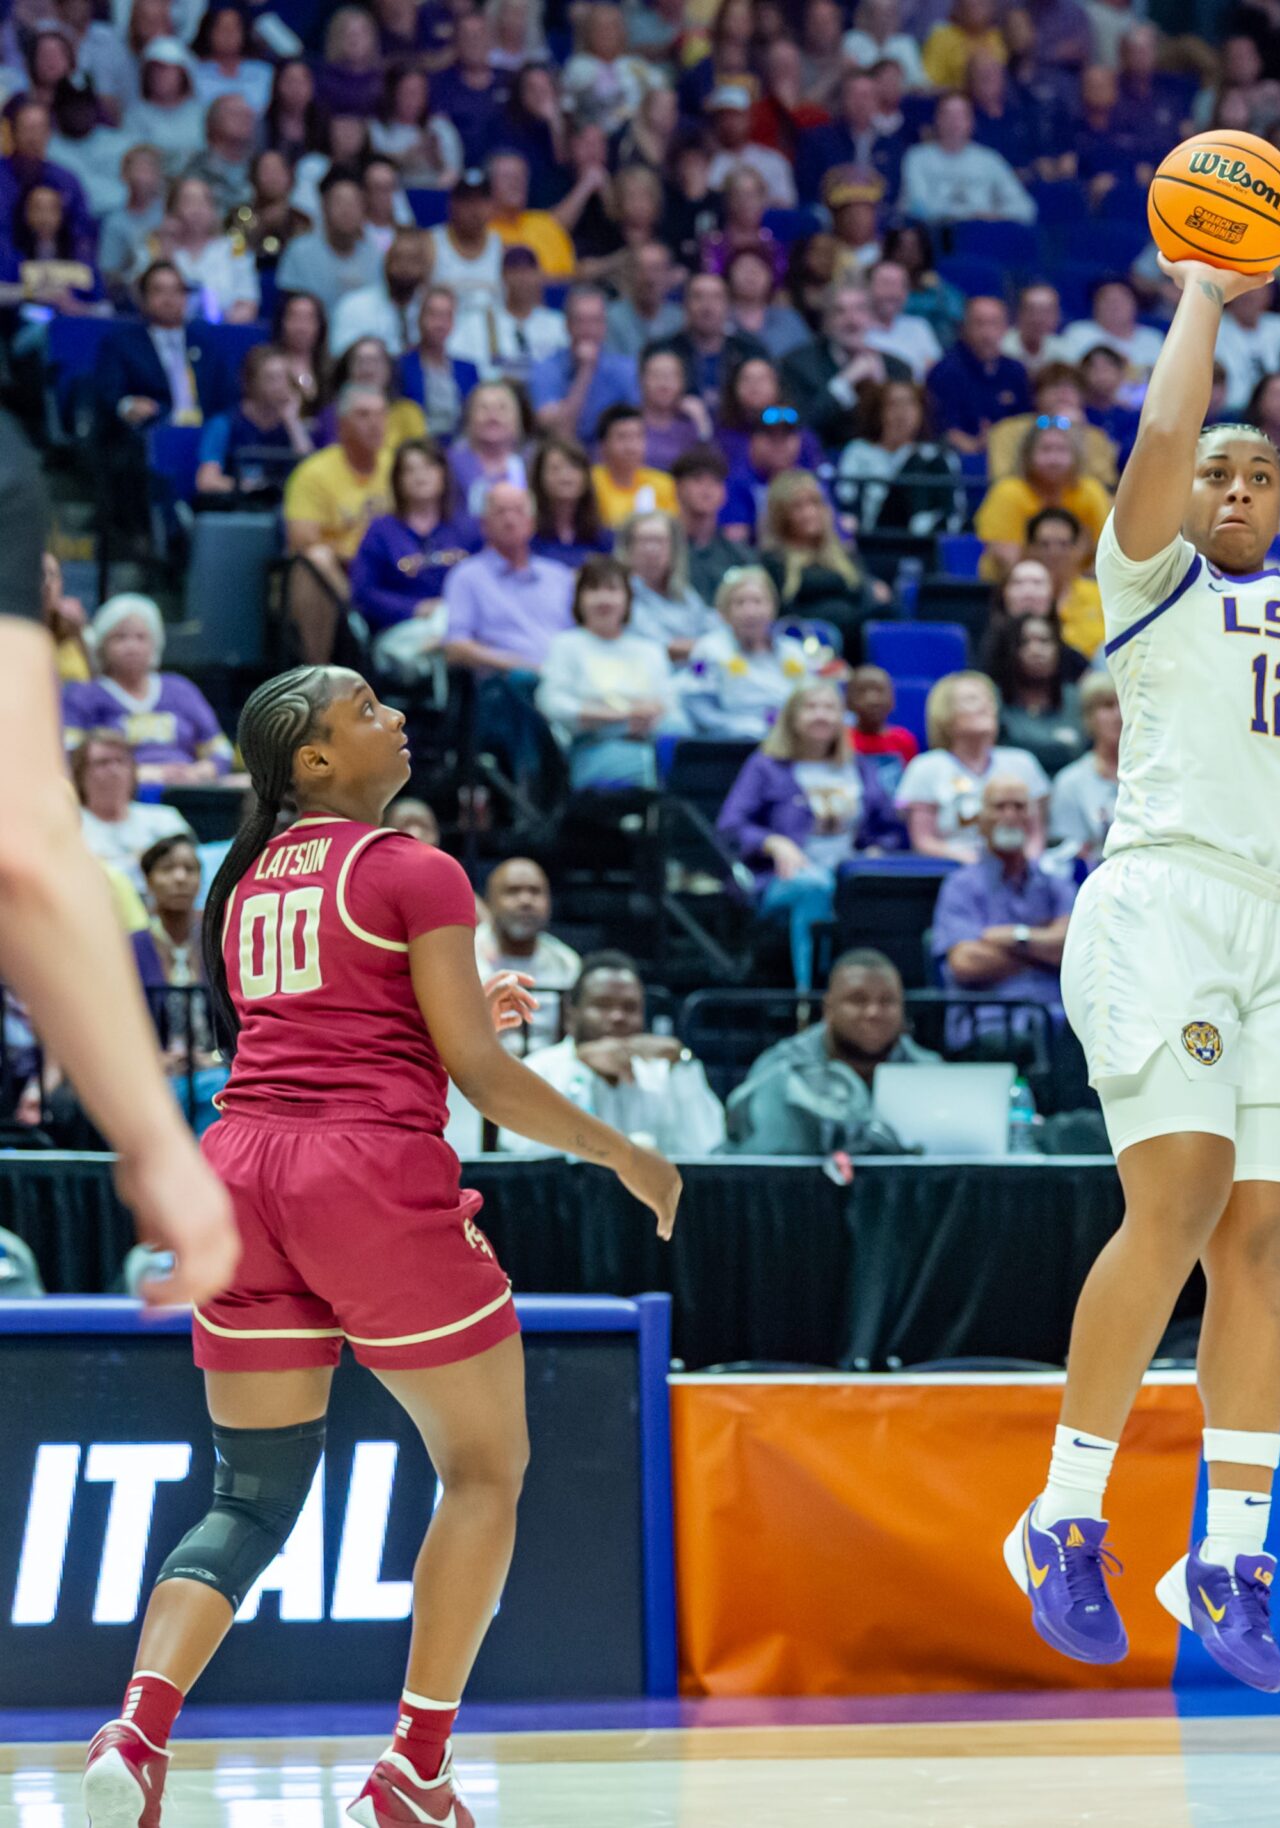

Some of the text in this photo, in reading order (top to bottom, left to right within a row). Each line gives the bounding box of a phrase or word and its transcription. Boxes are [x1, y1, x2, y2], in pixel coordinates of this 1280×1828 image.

[1201, 209, 1233, 230] MARCH
[254, 837, 333, 880] LATSON
[239, 886, 325, 999] 00
[11, 1440, 500, 1626] IT AL
